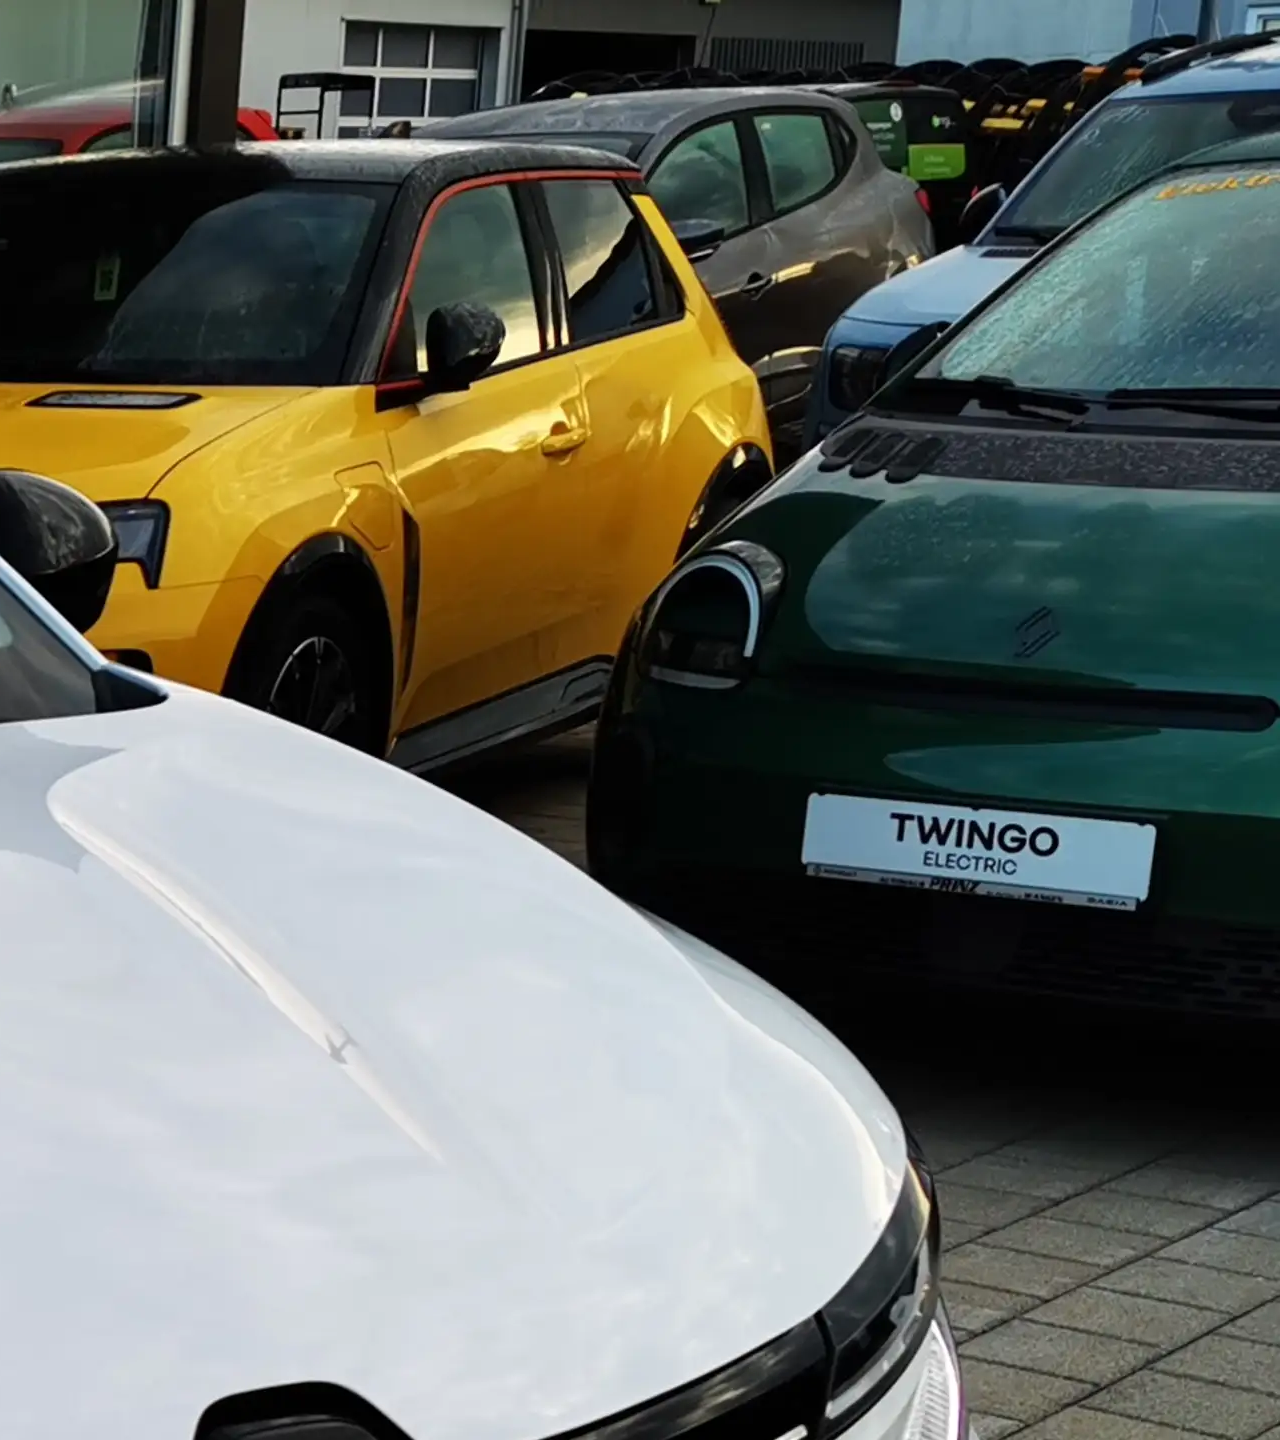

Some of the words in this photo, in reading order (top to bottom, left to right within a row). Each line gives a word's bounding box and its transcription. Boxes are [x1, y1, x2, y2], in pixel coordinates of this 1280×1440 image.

[890, 812, 1060, 857] TWINGO
[923, 850, 1018, 876] ELECTRIC
[928, 876, 982, 895] PRINZ
